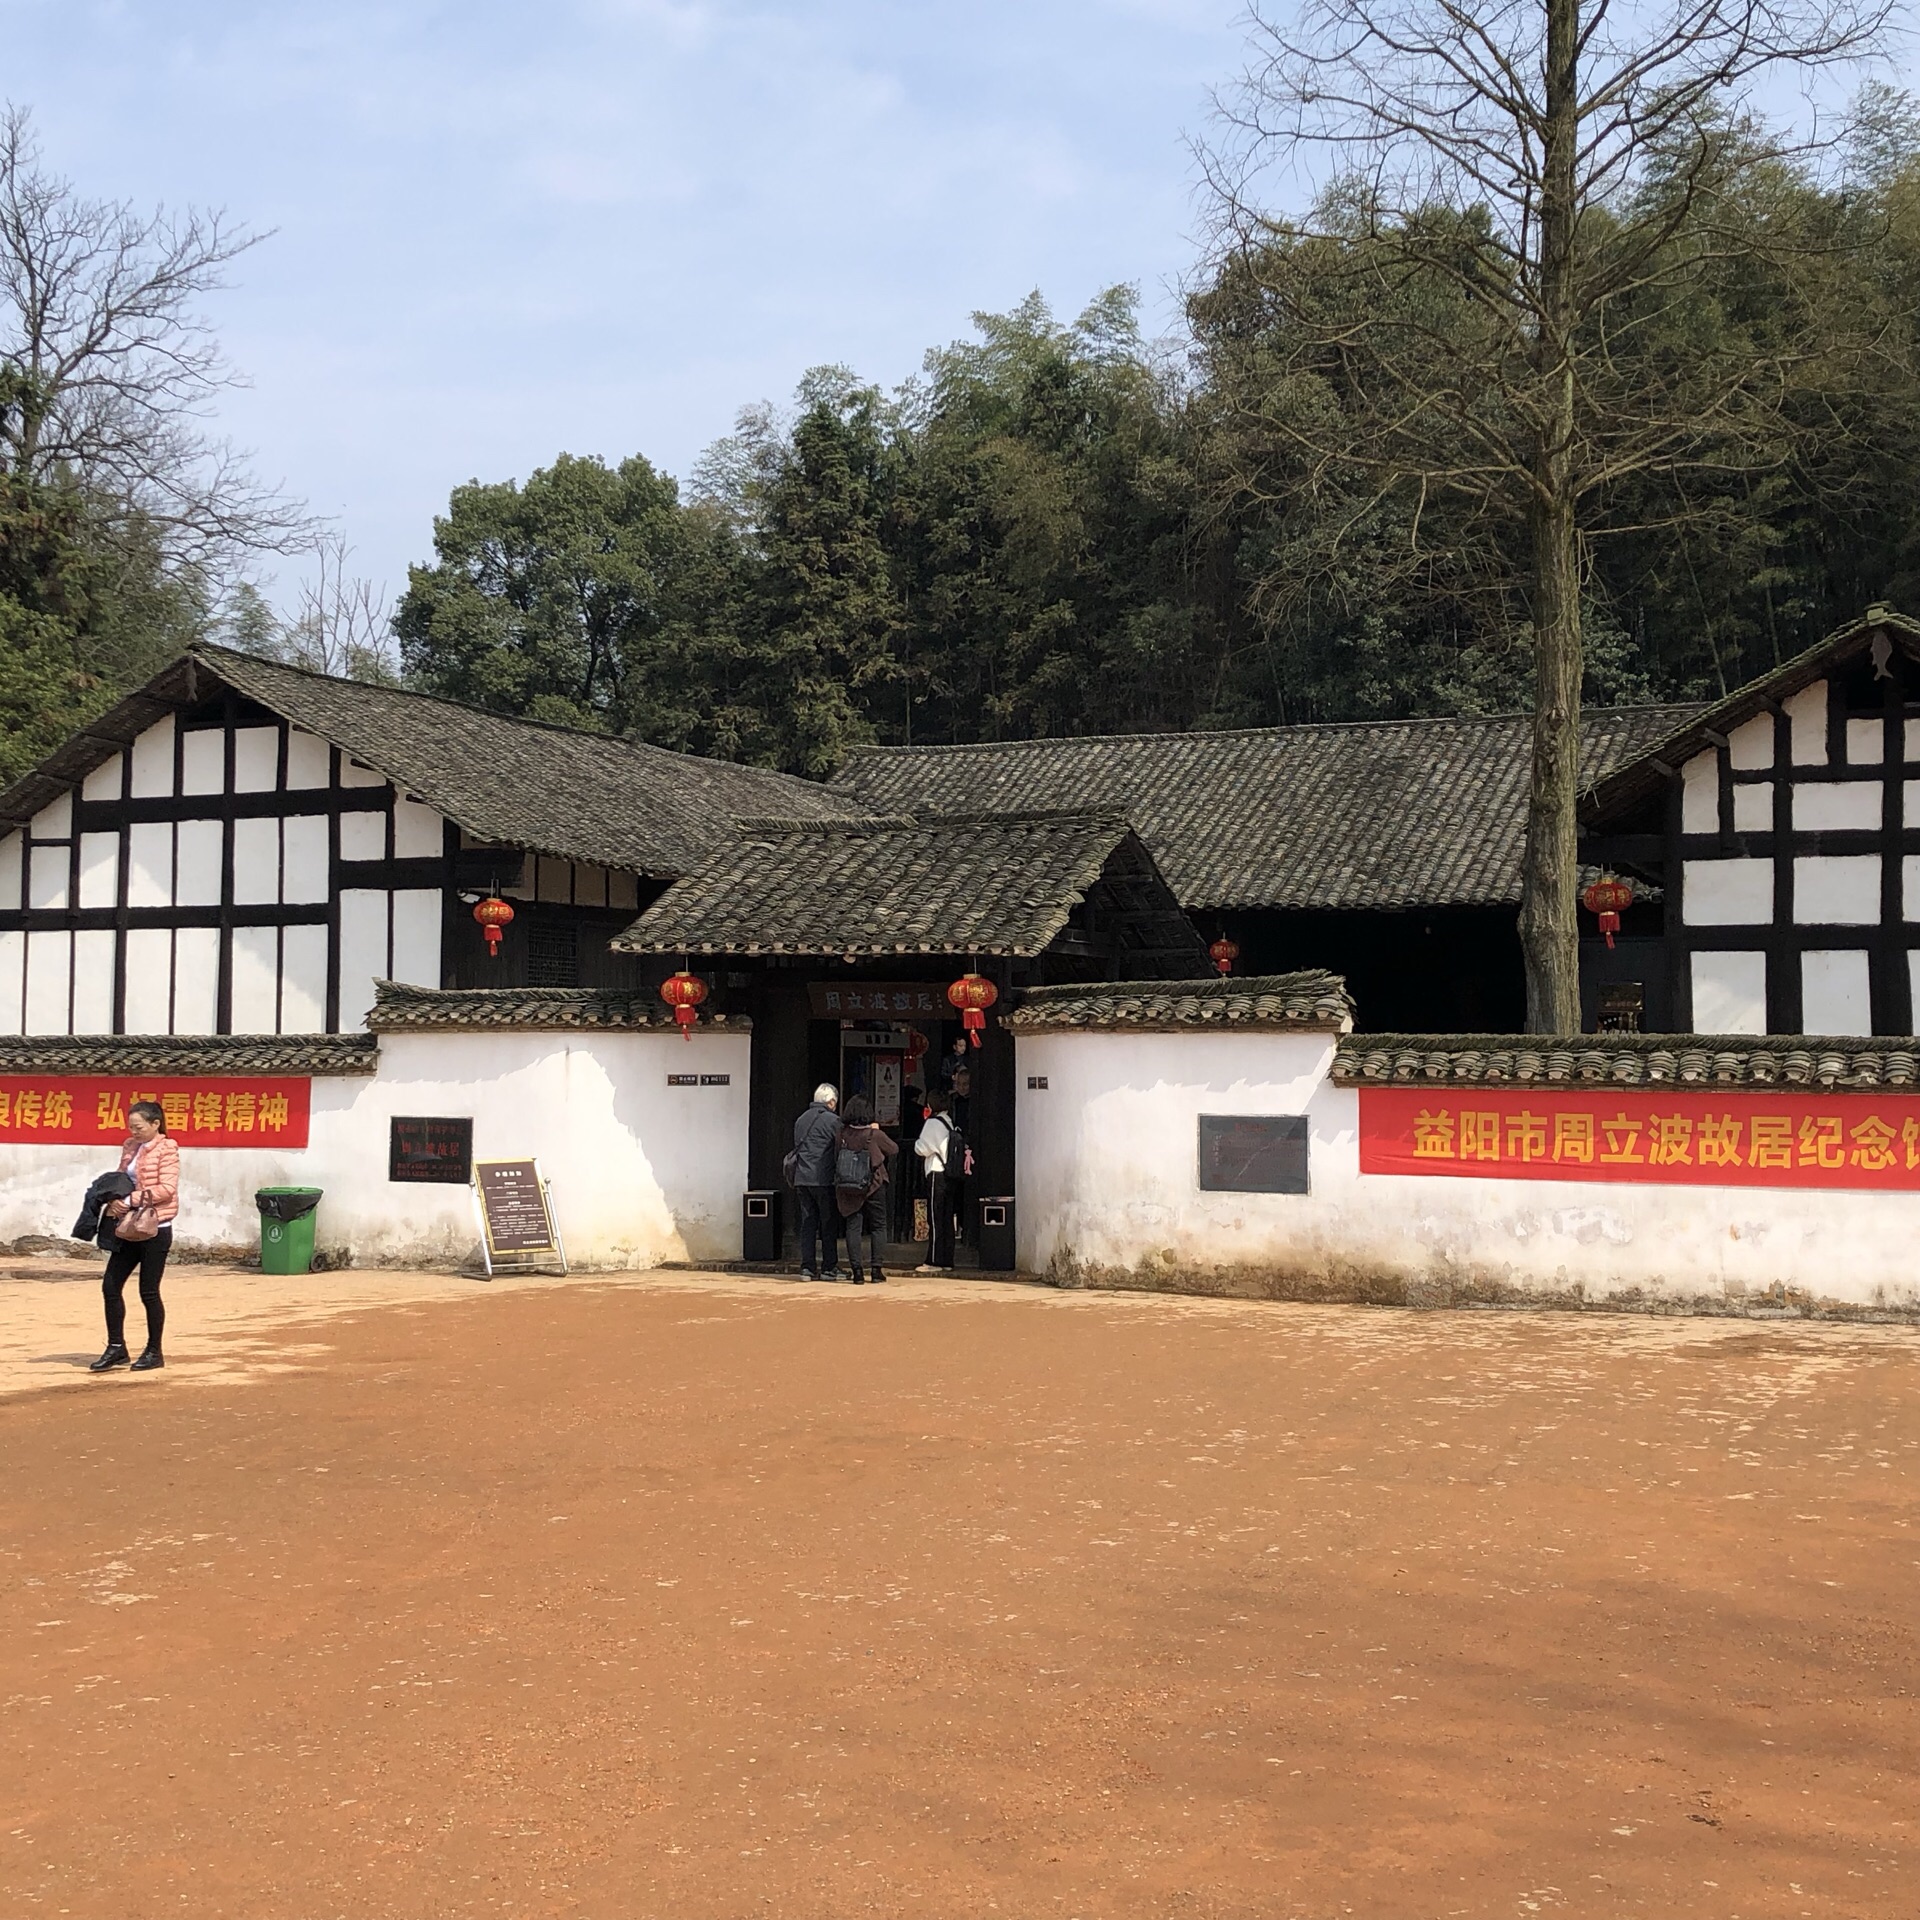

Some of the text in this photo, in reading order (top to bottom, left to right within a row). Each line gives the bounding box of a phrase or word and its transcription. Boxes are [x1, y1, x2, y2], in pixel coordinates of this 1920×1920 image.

[97, 1091, 289, 1132] 弘雷锋精神
